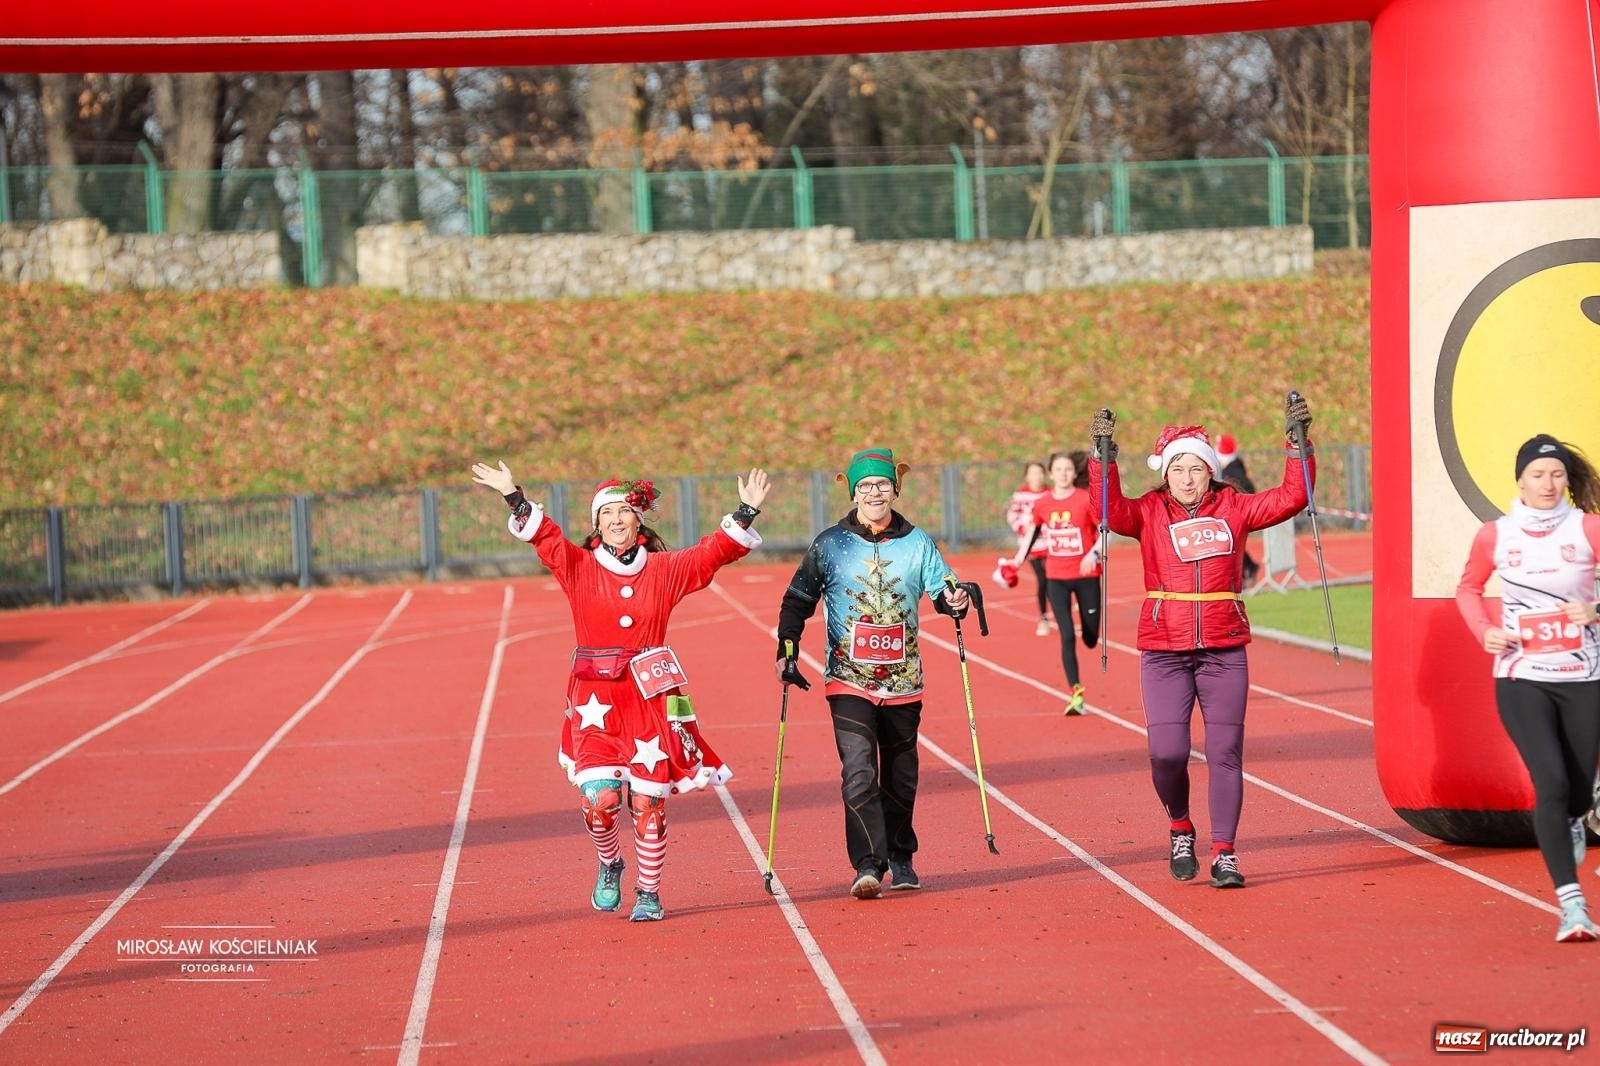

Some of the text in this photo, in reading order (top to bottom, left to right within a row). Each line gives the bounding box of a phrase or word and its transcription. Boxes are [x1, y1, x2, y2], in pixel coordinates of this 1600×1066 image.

[1191, 529, 1215, 546] 29
[1538, 621, 1563, 640] 31
[869, 634, 891, 650] 68
[651, 659, 671, 678] 69
